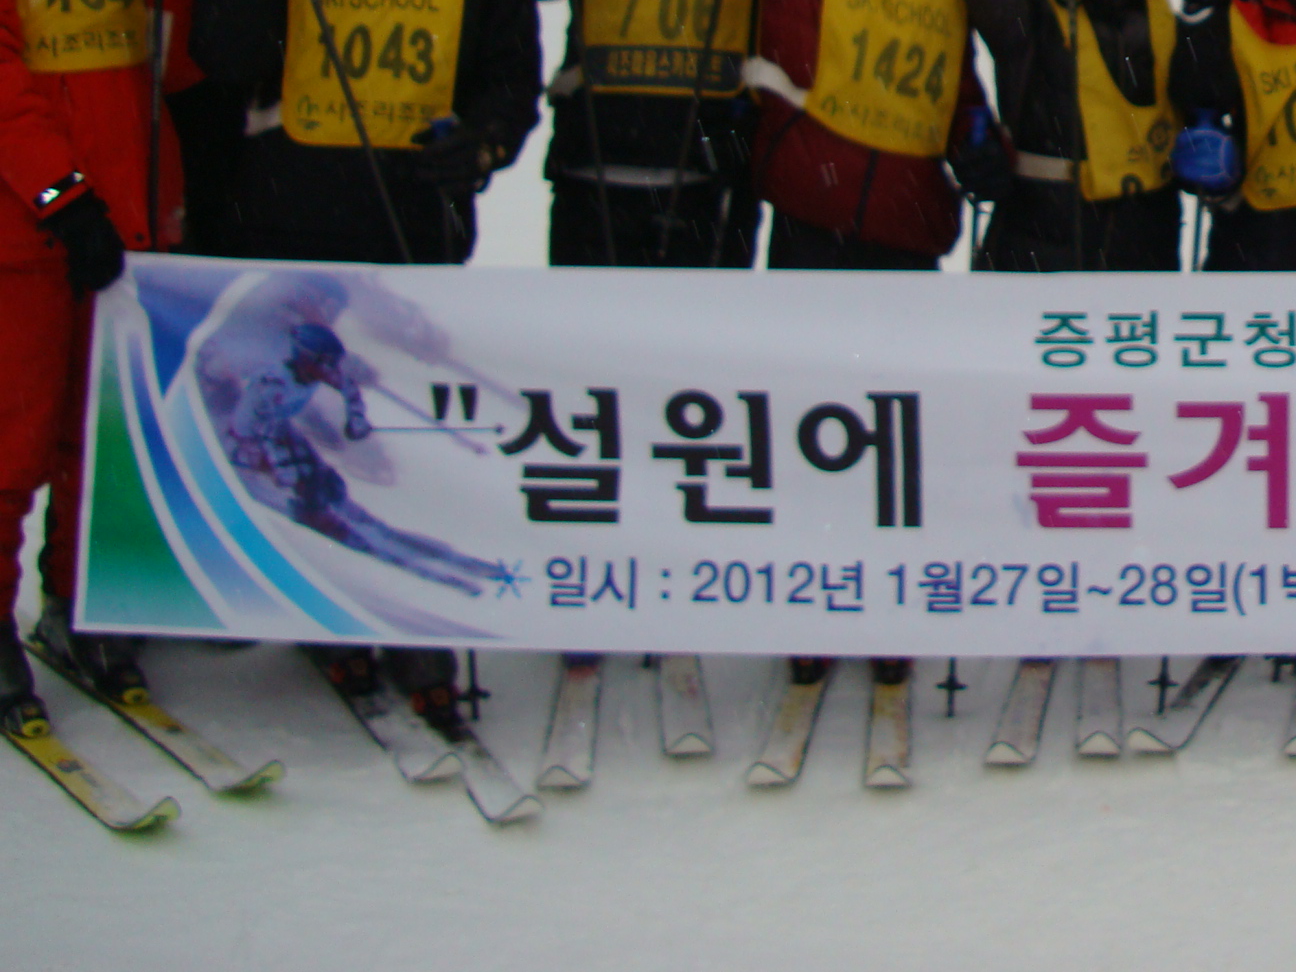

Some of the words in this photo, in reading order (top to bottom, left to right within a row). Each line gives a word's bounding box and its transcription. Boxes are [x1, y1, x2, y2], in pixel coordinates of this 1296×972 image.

[318, 21, 436, 85] 1043
[852, 29, 948, 105] 1424
[1259, 66, 1292, 96] SKI
[546, 556, 639, 610] 일시
[691, 560, 866, 613] 2012년
